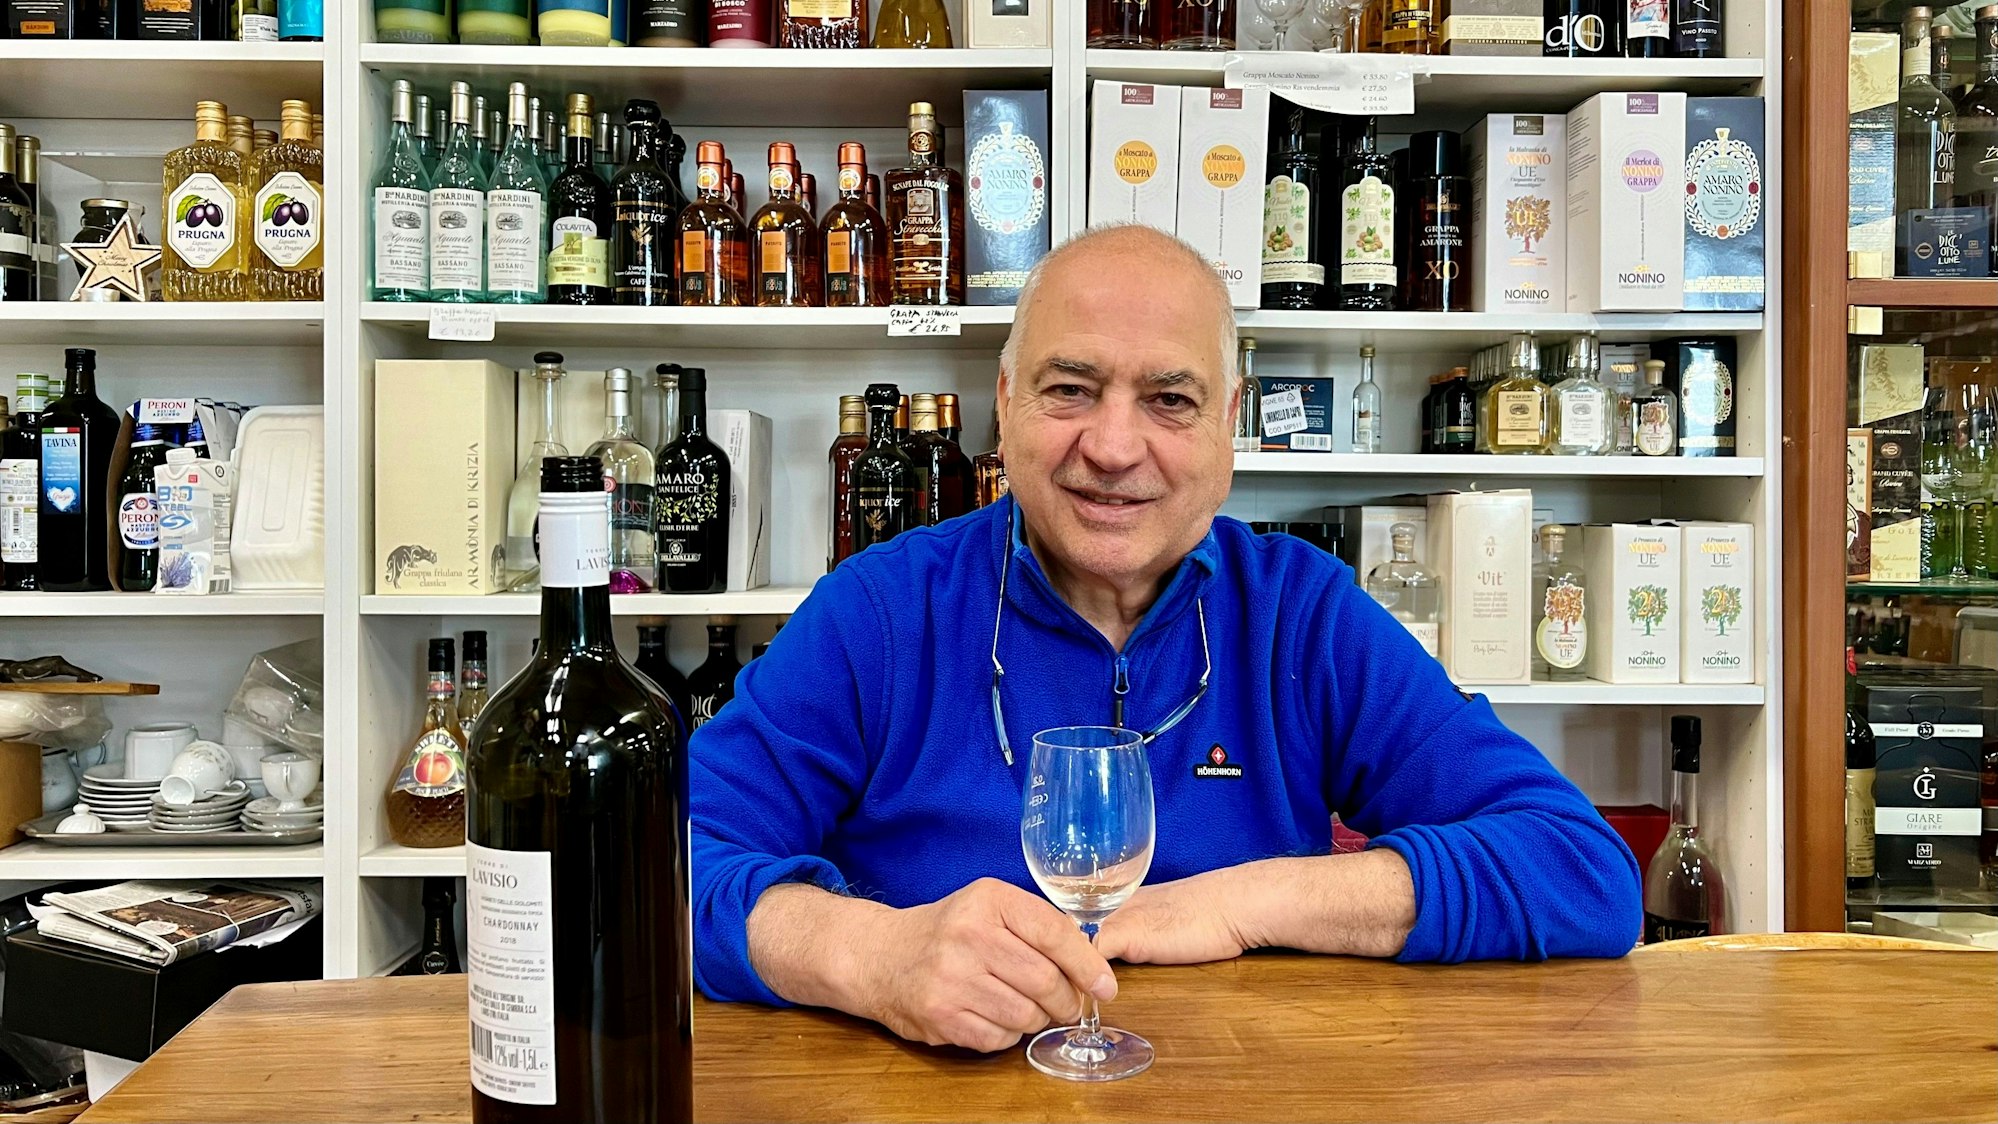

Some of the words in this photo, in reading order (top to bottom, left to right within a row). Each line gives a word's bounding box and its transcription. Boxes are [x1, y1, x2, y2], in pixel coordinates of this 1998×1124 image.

[1123, 148, 1148, 157] Moscato
[1212, 152, 1236, 161] Moscato
[1116, 157, 1155, 168] NONINO
[1506, 154, 1551, 166] NONINO
[988, 170, 1028, 180] AMARO
[1120, 168, 1150, 178] GRAPPA
[1519, 166, 1537, 177] UE
[1622, 166, 1663, 176] NONINO
[1208, 172, 1238, 182] GRAPPA
[1627, 177, 1657, 186] GRAPPA
[1704, 175, 1743, 185] AMARO
[987, 179, 1028, 190] NONINO
[1702, 184, 1744, 195] NONINO
[395, 192, 427, 202] NARDINI
[894, 217, 946, 235] Stravecchi
[907, 217, 933, 225] GRAPPA
[178, 230, 225, 239] PRUGNA
[265, 229, 311, 237] PRUGNA
[1940, 247, 1960, 256] OTTO
[1938, 256, 1960, 265] LUNE
[1424, 261, 1460, 280] XO
[1619, 273, 1665, 283] NONINO
[1504, 290, 1549, 299] NONINO
[148, 401, 186, 409] PERONI
[45, 438, 77, 447] TAVINA
[468, 442, 478, 492] KRIZIA
[656, 473, 705, 485] AMARO
[121, 513, 158, 523] PERON
[1628, 543, 1667, 553] NONINO
[1700, 543, 1739, 553] NONINO
[1640, 553, 1656, 564] UE
[1713, 553, 1730, 564] UE
[404, 568, 432, 578] Grappa
[434, 568, 462, 577] friulana
[419, 578, 447, 587] classica
[1559, 649, 1573, 658] UE
[1628, 657, 1666, 665] NONINO
[1702, 657, 1740, 665] NONINO
[1197, 766, 1241, 776] HÖHENHORN
[1906, 813, 1942, 824] GIARE
[1907, 823, 1942, 831] Origine
[473, 868, 517, 889] LAVISIO
[483, 917, 539, 931] CHARDONNAY
